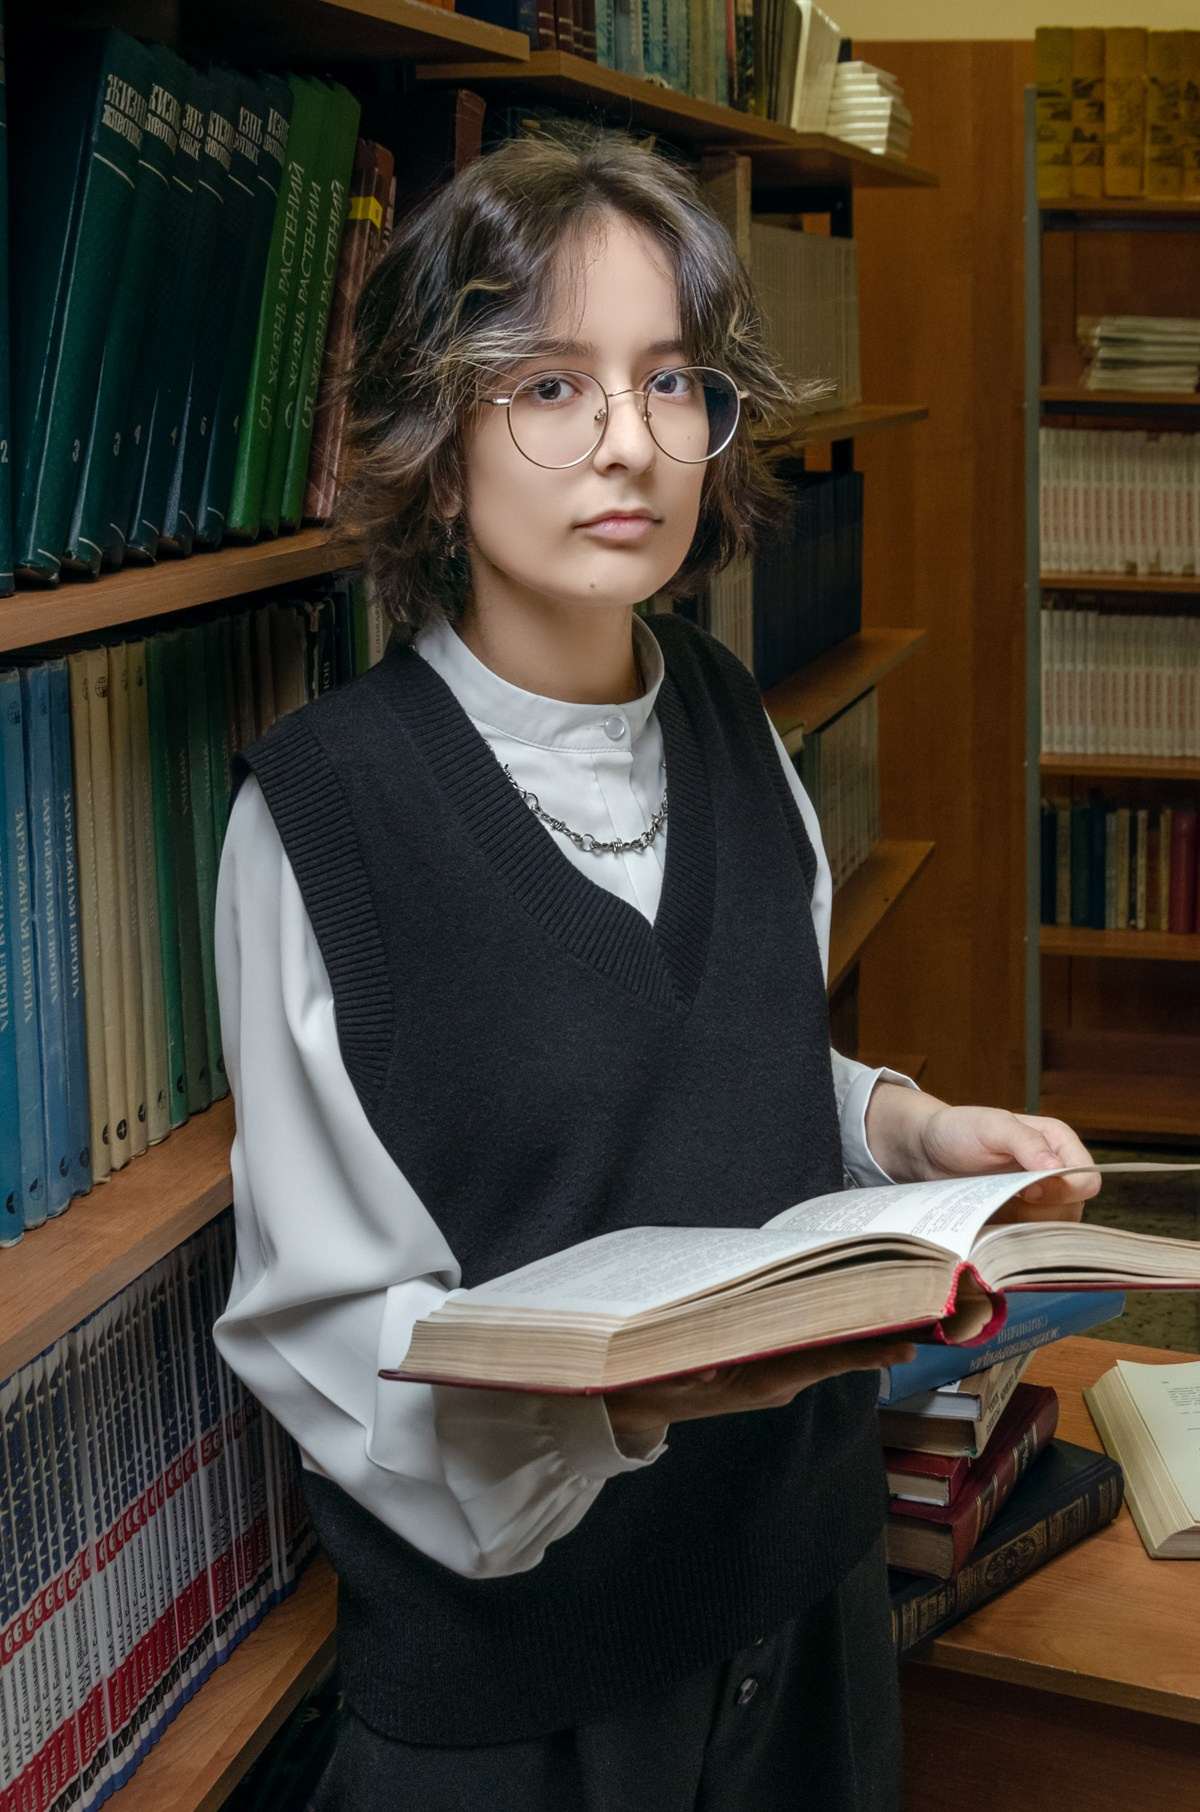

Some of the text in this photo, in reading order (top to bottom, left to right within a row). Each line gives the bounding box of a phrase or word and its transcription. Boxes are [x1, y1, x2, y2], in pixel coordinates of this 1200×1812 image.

[269, 161, 305, 384] ЖИЗНЬ РАСТЕНИЙ
[310, 178, 344, 386] ЖИЗНЬ РАСТЕНИЙ
[288, 311, 305, 389] ЖИЗНЬ
[258, 394, 272, 429] 5
[301, 394, 314, 429] 5
[0, 440, 8, 463] 2
[72, 439, 81, 462] 3
[15, 804, 34, 1025] ЗАРУБЕЖНАЯ ЕВРОПА
[42, 792, 59, 1005] ЗАРУБЕЖНАЯ ЕВРОПА
[63, 788, 80, 999] ЗАРУБЕЖНАЯ ЕВРОПА
[26, 1608, 34, 1632] 6
[34, 1596, 43, 1620] 6
[44, 1585, 54, 1610] 6
[4, 1629, 12, 1654] 6
[13, 1619, 22, 1643] 6
[50, 1621, 60, 1690] Башмаков
[73, 1601, 84, 1669] Башмаков
[31, 1643, 42, 1713] Башмаков
